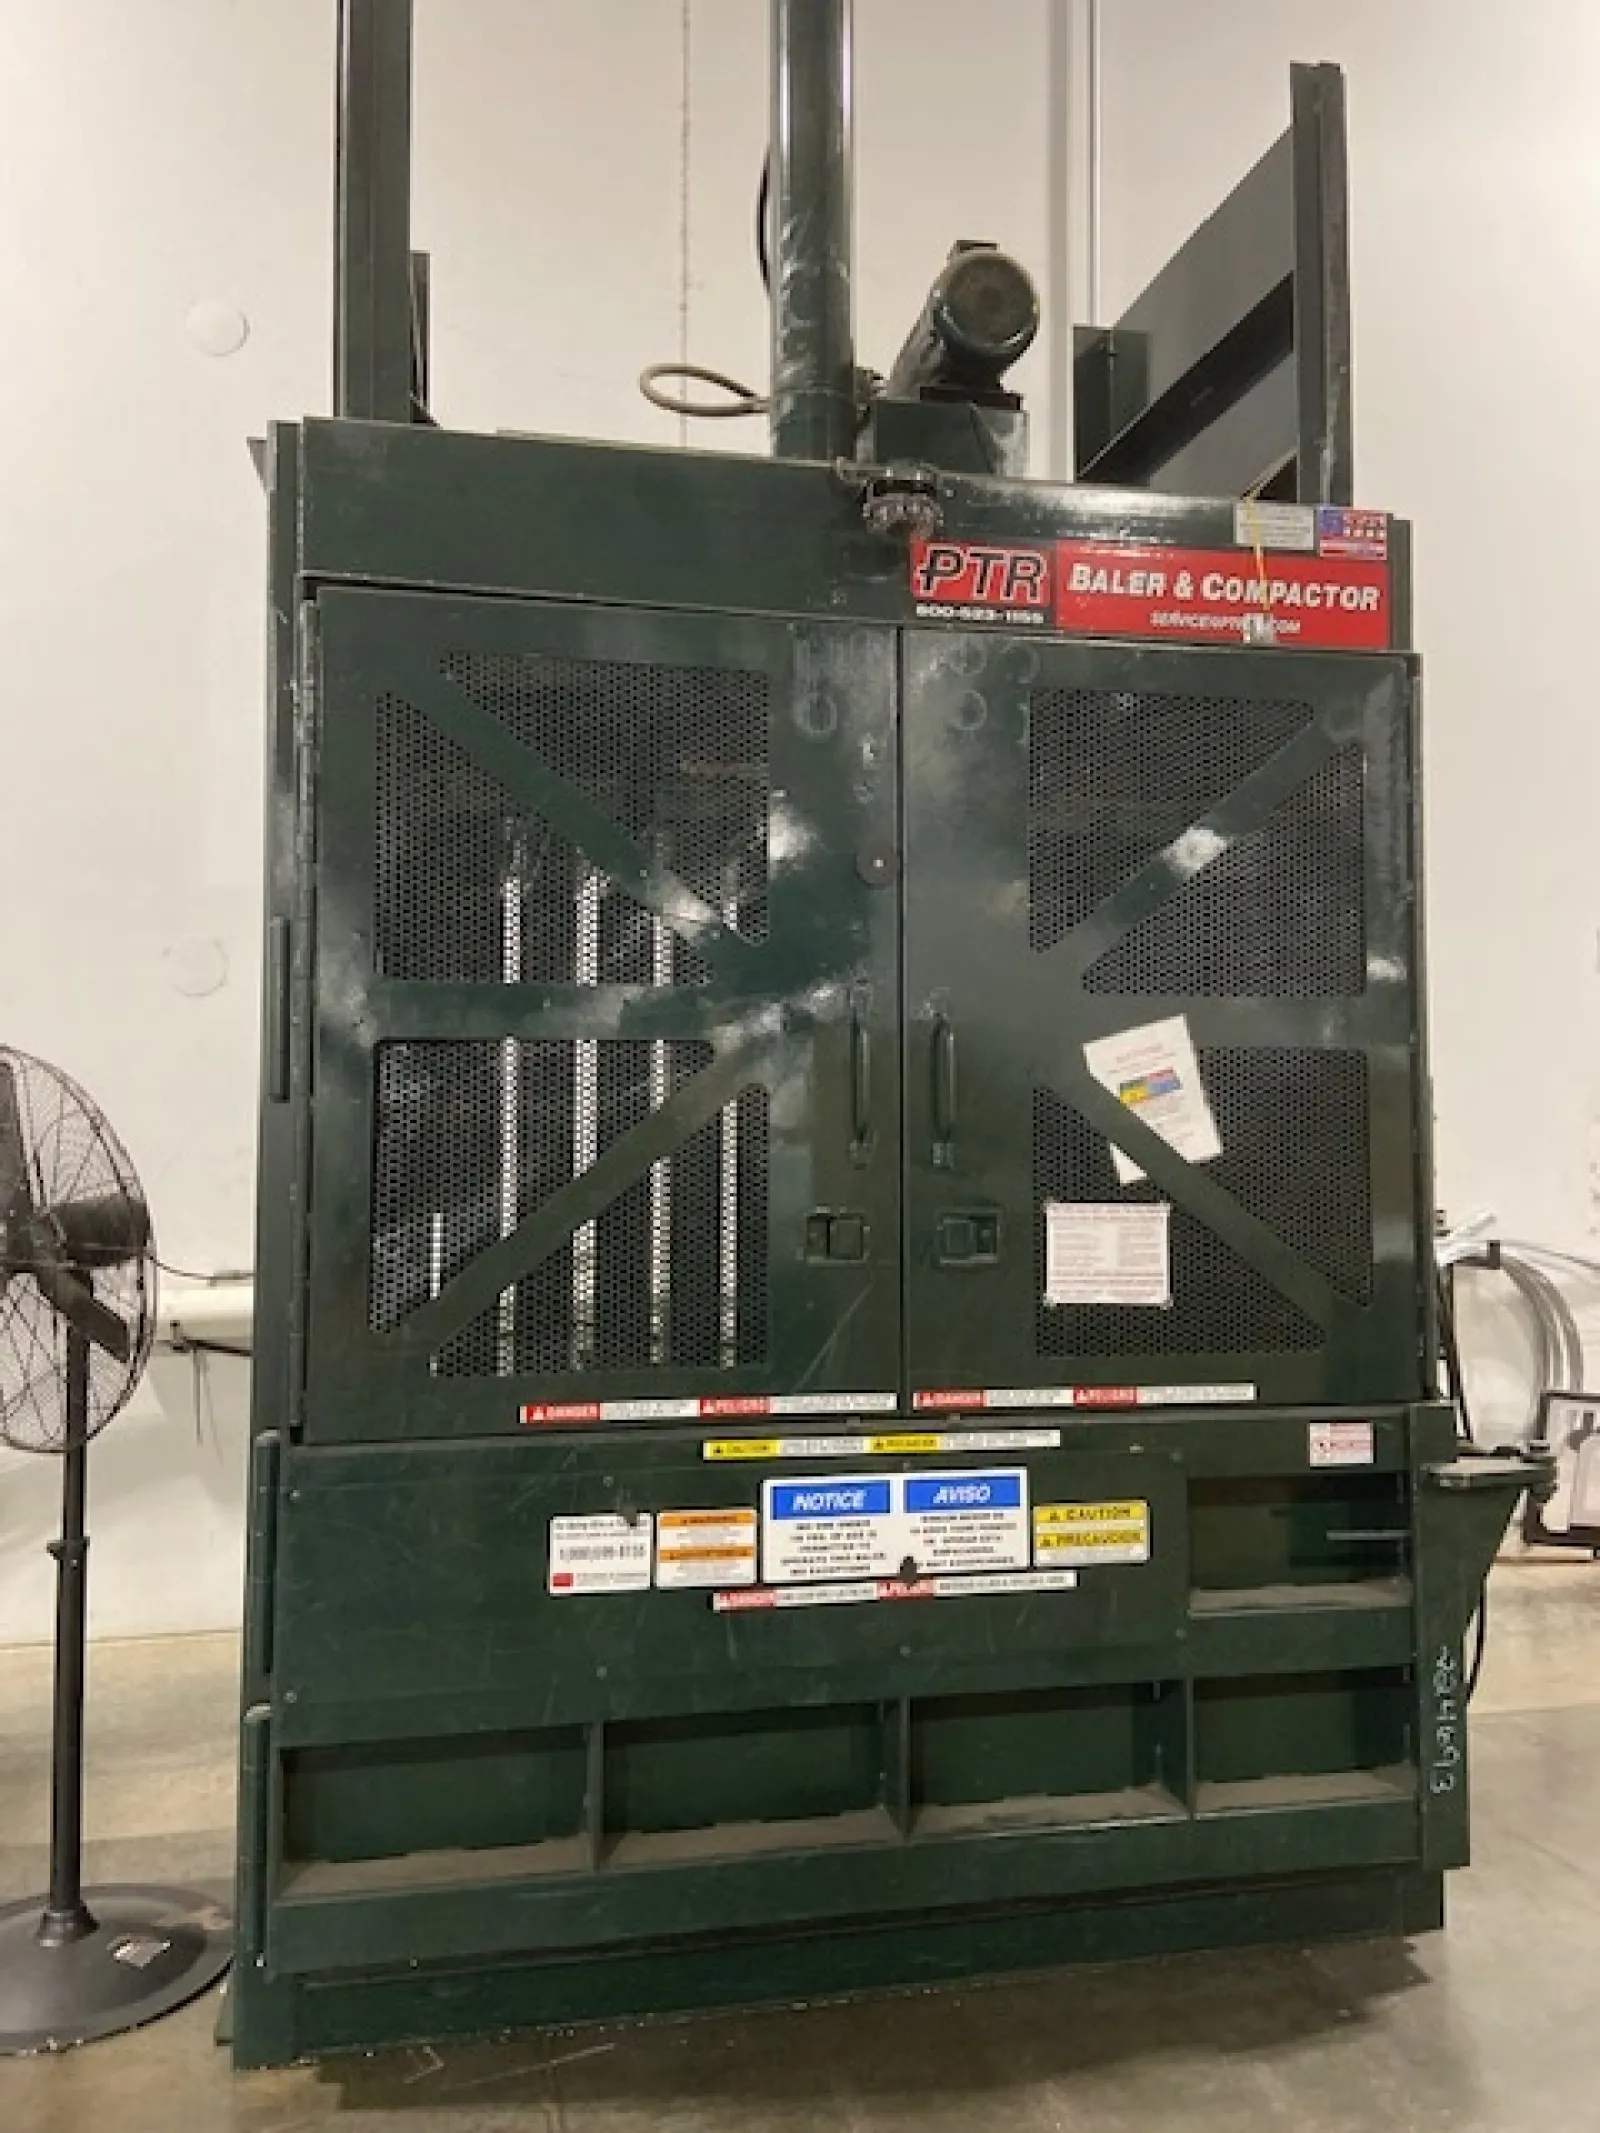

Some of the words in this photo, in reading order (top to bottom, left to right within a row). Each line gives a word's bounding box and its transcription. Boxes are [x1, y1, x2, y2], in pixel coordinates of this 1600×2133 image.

[914, 543, 1048, 603] PTR
[1066, 562, 1167, 598] BALER
[1173, 568, 1194, 601] &
[1199, 572, 1382, 611] COMPACTOR
[792, 1489, 867, 1511] NOTICE
[932, 1482, 991, 1504] AVISO
[1066, 1505, 1131, 1520] CAUTION
